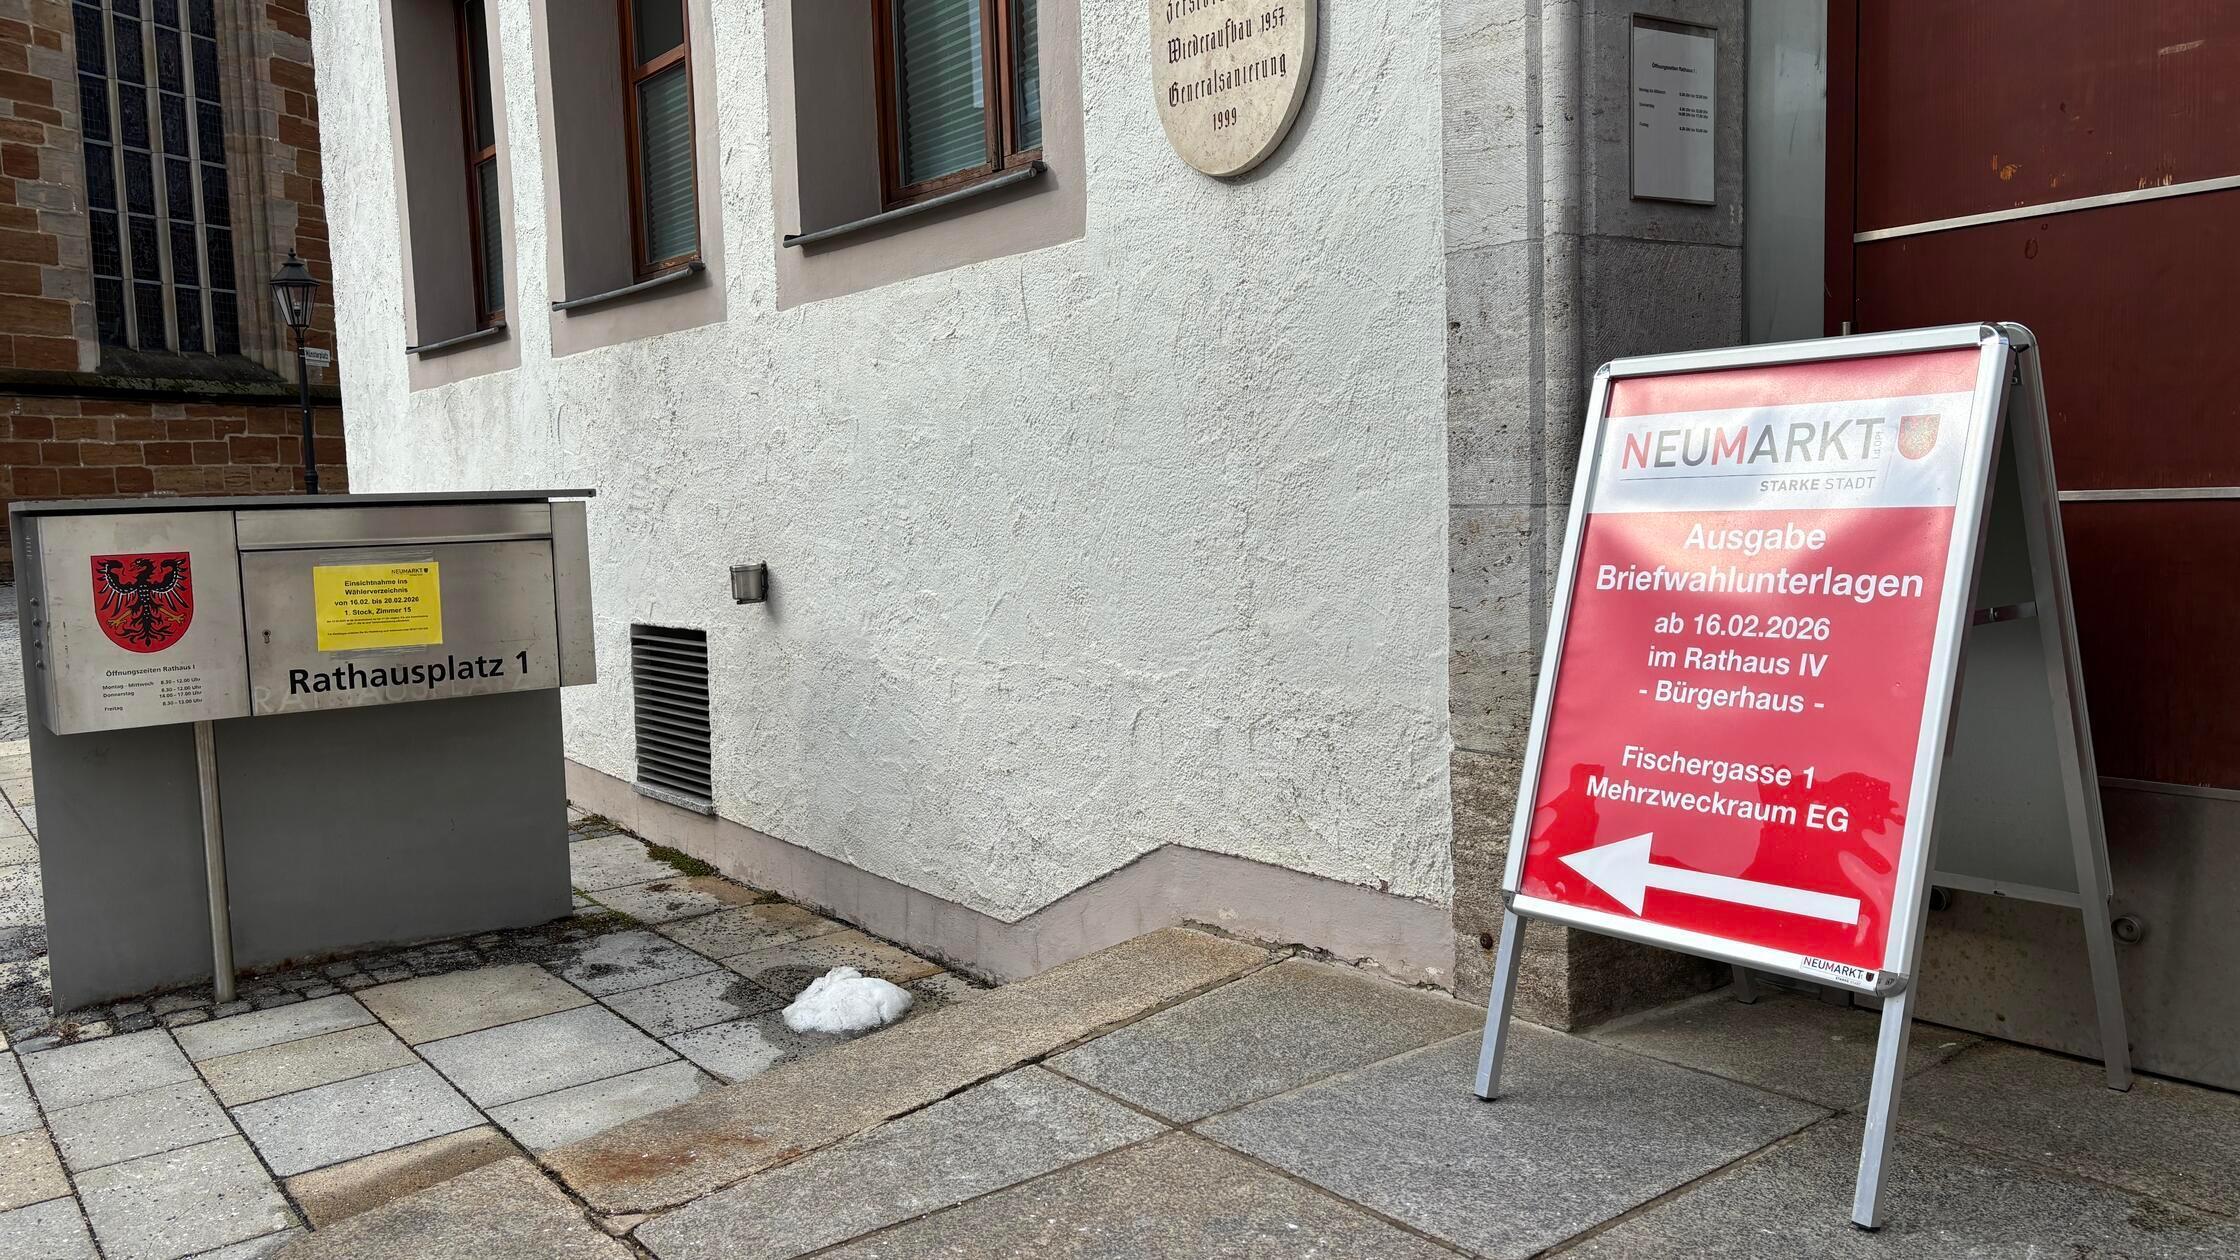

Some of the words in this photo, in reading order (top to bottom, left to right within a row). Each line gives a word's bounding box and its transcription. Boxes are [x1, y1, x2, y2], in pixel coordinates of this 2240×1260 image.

[1167, 18, 1252, 64] Wiederaufbau
[1260, 7, 1285, 33] 1957
[1168, 53, 1287, 107] Generalsanierung
[1212, 107, 1237, 131] 1999
[1621, 416, 1885, 470] NEUMARKT
[1759, 478, 1820, 493] STARKE
[1823, 476, 1876, 491] STADT
[1683, 522, 1827, 557] Ausgabe
[344, 579, 396, 587] Einsichtnahme
[344, 587, 408, 596] Wählerverzeichnis
[1595, 563, 1924, 603] Briefwahlunterlagen
[352, 608, 375, 616] Stock,
[384, 596, 419, 604] 20.02.2026
[1654, 612, 1685, 635] ab
[1693, 613, 1831, 641] 16.02.2026
[106, 667, 161, 677] Öffnungszeiten
[162, 664, 191, 673] Rathaus
[289, 654, 505, 694] Rathausplatz
[516, 650, 528, 674] 1
[1647, 645, 1677, 667] im
[1683, 647, 1790, 675] Rathaus
[1798, 653, 1828, 678] IV
[1654, 680, 1805, 713] Bürgerhaus
[1621, 745, 1792, 787] Fischergasse
[1802, 766, 1816, 790] 1
[1586, 775, 1798, 826] Mehrzweckraum
[1806, 804, 1850, 833] EG
[1803, 956, 1864, 980] NEUMARKT
